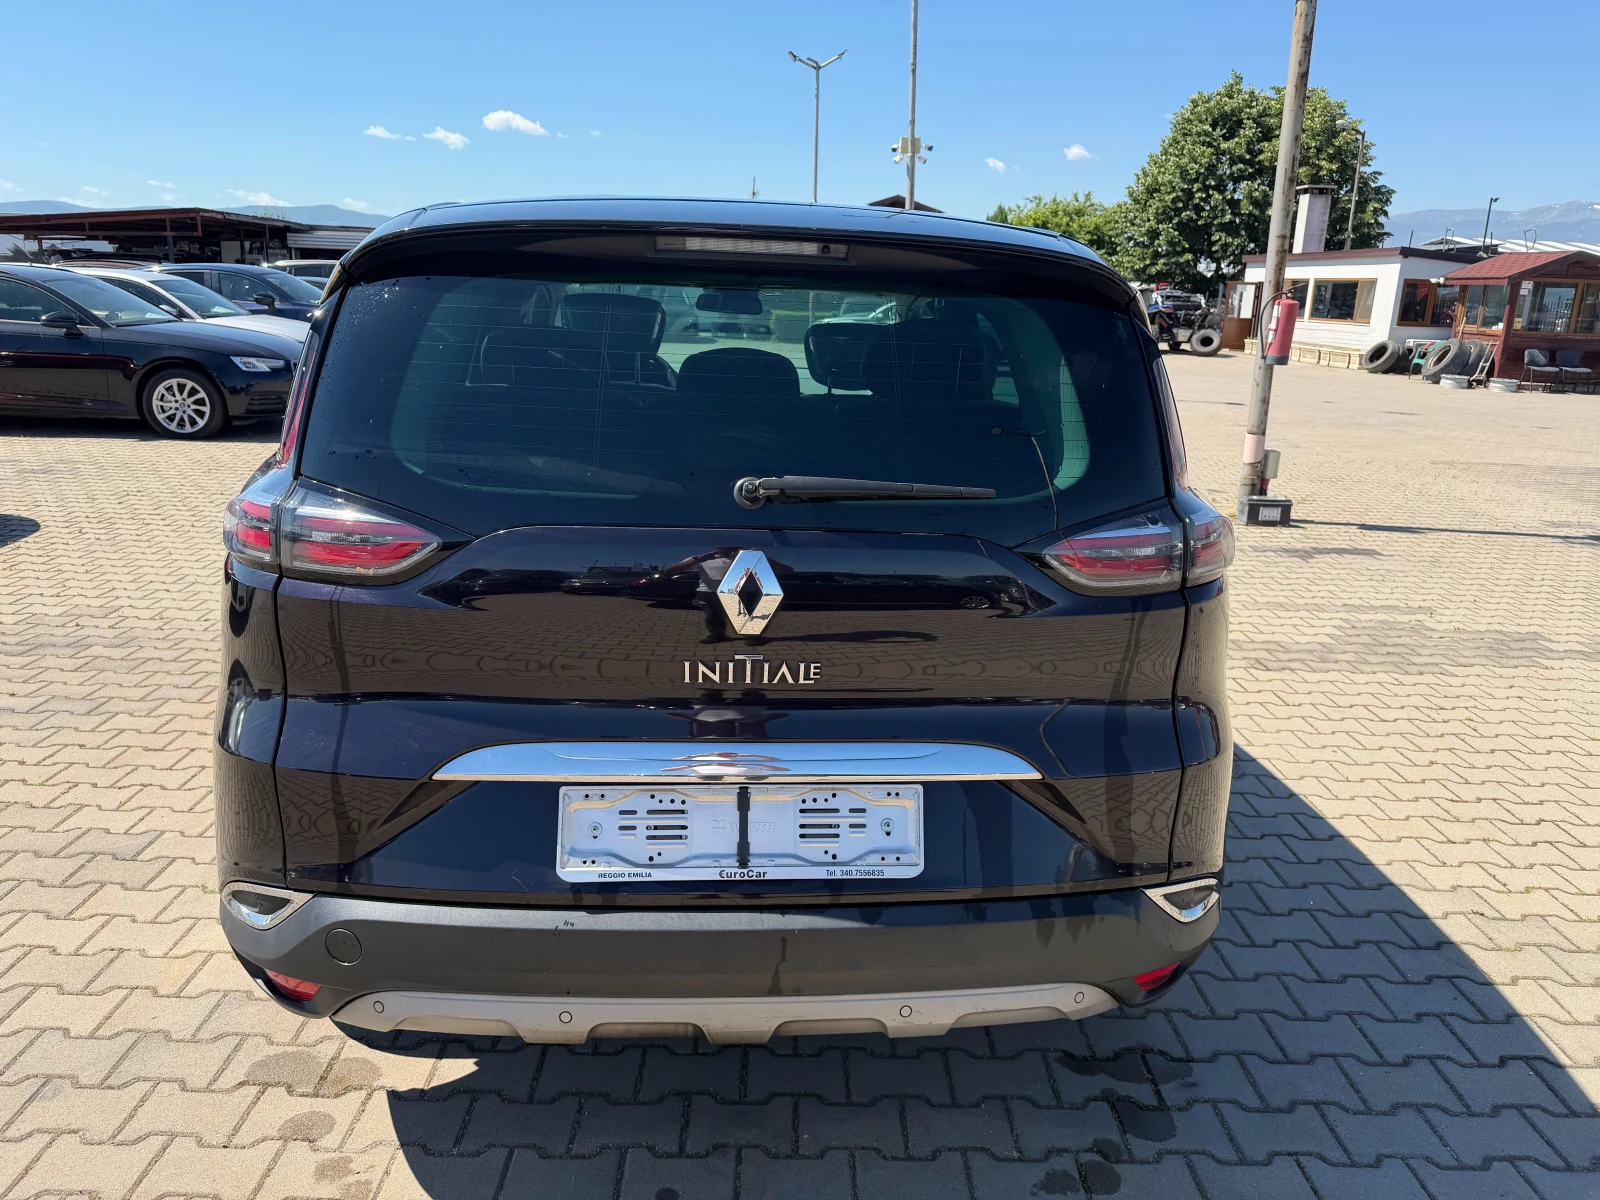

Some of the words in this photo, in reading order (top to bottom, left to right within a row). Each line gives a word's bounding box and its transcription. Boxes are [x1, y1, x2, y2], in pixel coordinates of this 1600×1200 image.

[683, 654, 821, 685] INITIALE
[729, 821, 775, 833] WRTH
[627, 871, 653, 879] EMILIA
[825, 869, 838, 877] Tel.
[839, 869, 885, 877] 340.7556835
